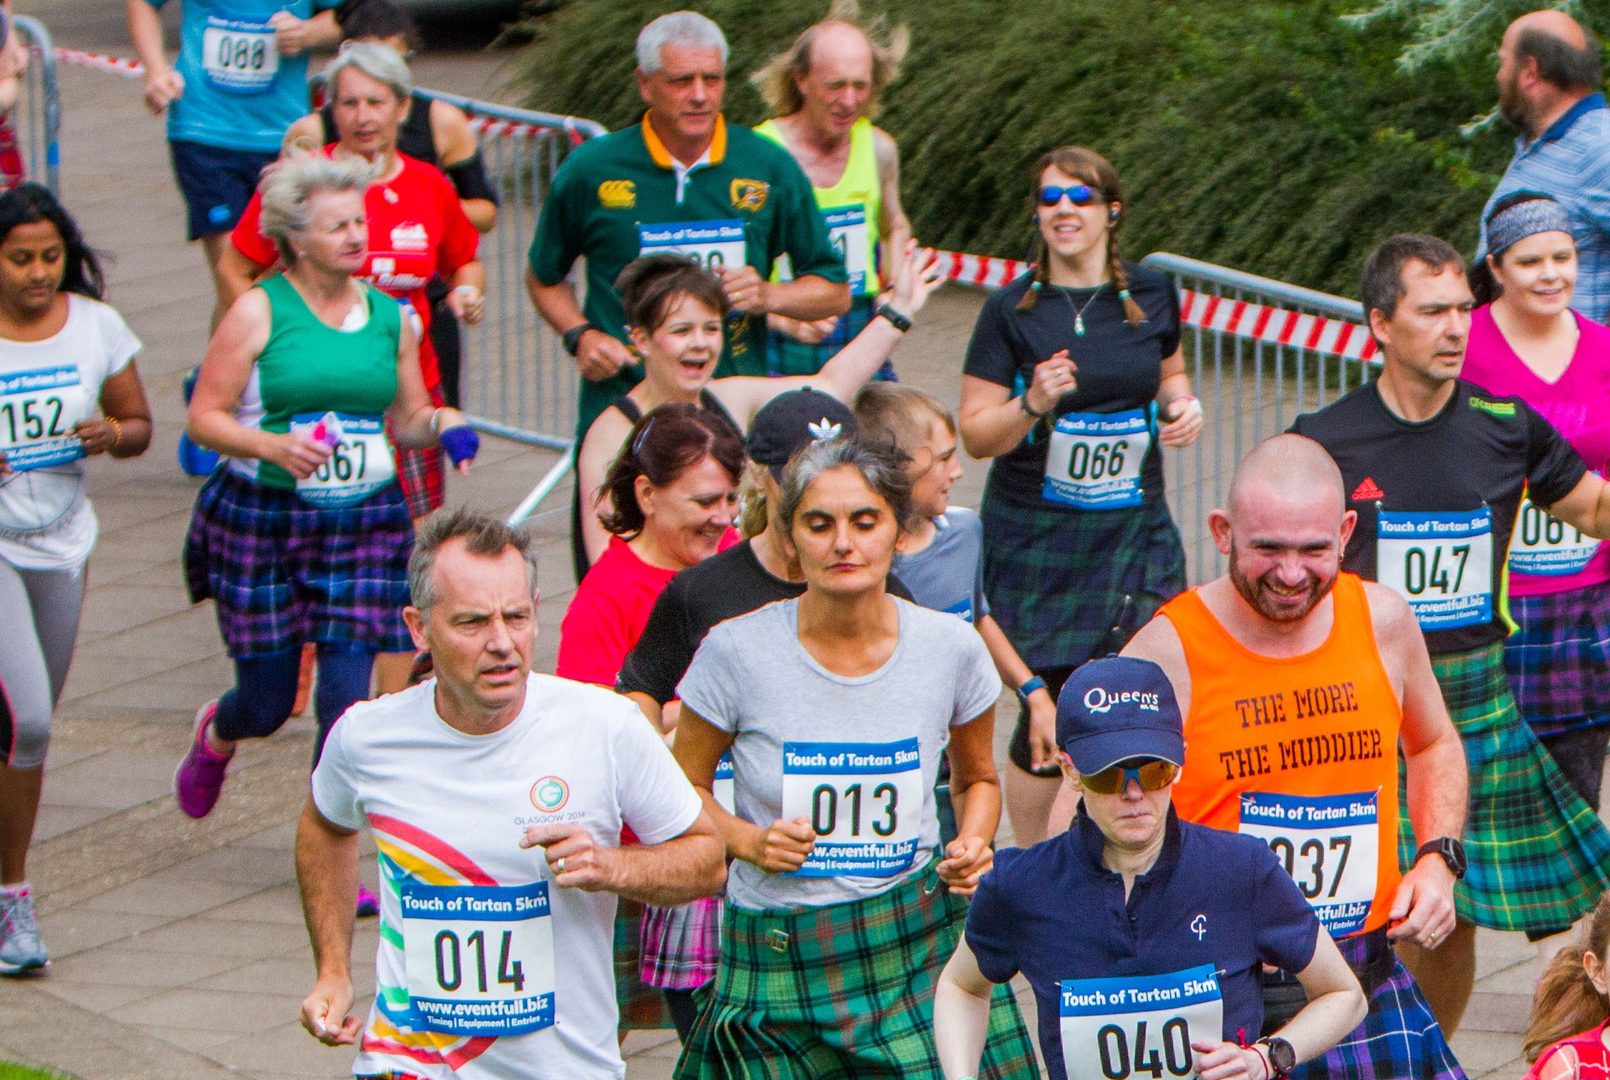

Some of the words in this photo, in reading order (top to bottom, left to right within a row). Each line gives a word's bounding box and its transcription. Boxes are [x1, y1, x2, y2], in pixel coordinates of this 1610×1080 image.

[218, 36, 265, 69] 088
[1, 396, 65, 442] 152
[1068, 440, 1129, 480] 066
[1380, 520, 1415, 532] Touch
[1417, 521, 1430, 533] of
[1431, 520, 1470, 532] Tartan
[1471, 517, 1489, 530] 5km
[1405, 544, 1470, 595] 047
[1084, 688, 1158, 714] Queen's
[1235, 693, 1286, 728] THE
[1293, 681, 1358, 719] MORE
[786, 752, 826, 767] Touch
[829, 752, 844, 767] of
[847, 753, 892, 766] Tartan
[895, 750, 918, 765] 5km
[1220, 745, 1271, 780] THE
[1278, 729, 1382, 771] MUDDIER
[514, 813, 564, 826] GLASGOW
[812, 782, 898, 837] 013
[1242, 801, 1285, 818] Touch
[1288, 807, 1303, 820] of
[1306, 807, 1346, 821] Tartan
[1349, 803, 1376, 818] 5km
[831, 859, 876, 871] Equipment
[402, 896, 444, 911] Touch
[447, 896, 462, 911] of
[465, 898, 512, 912] Tartan
[516, 895, 548, 911] 5km
[434, 929, 525, 993] 014
[417, 997, 548, 1016] www.eventfull.biz
[1063, 991, 1106, 1007] Touch
[1109, 989, 1126, 1005] of
[1128, 987, 1181, 1003] Tartan
[1184, 979, 1217, 997] 5km
[427, 1015, 453, 1029] Timing
[458, 1018, 505, 1029] Equipment
[511, 1014, 541, 1027] Entries
